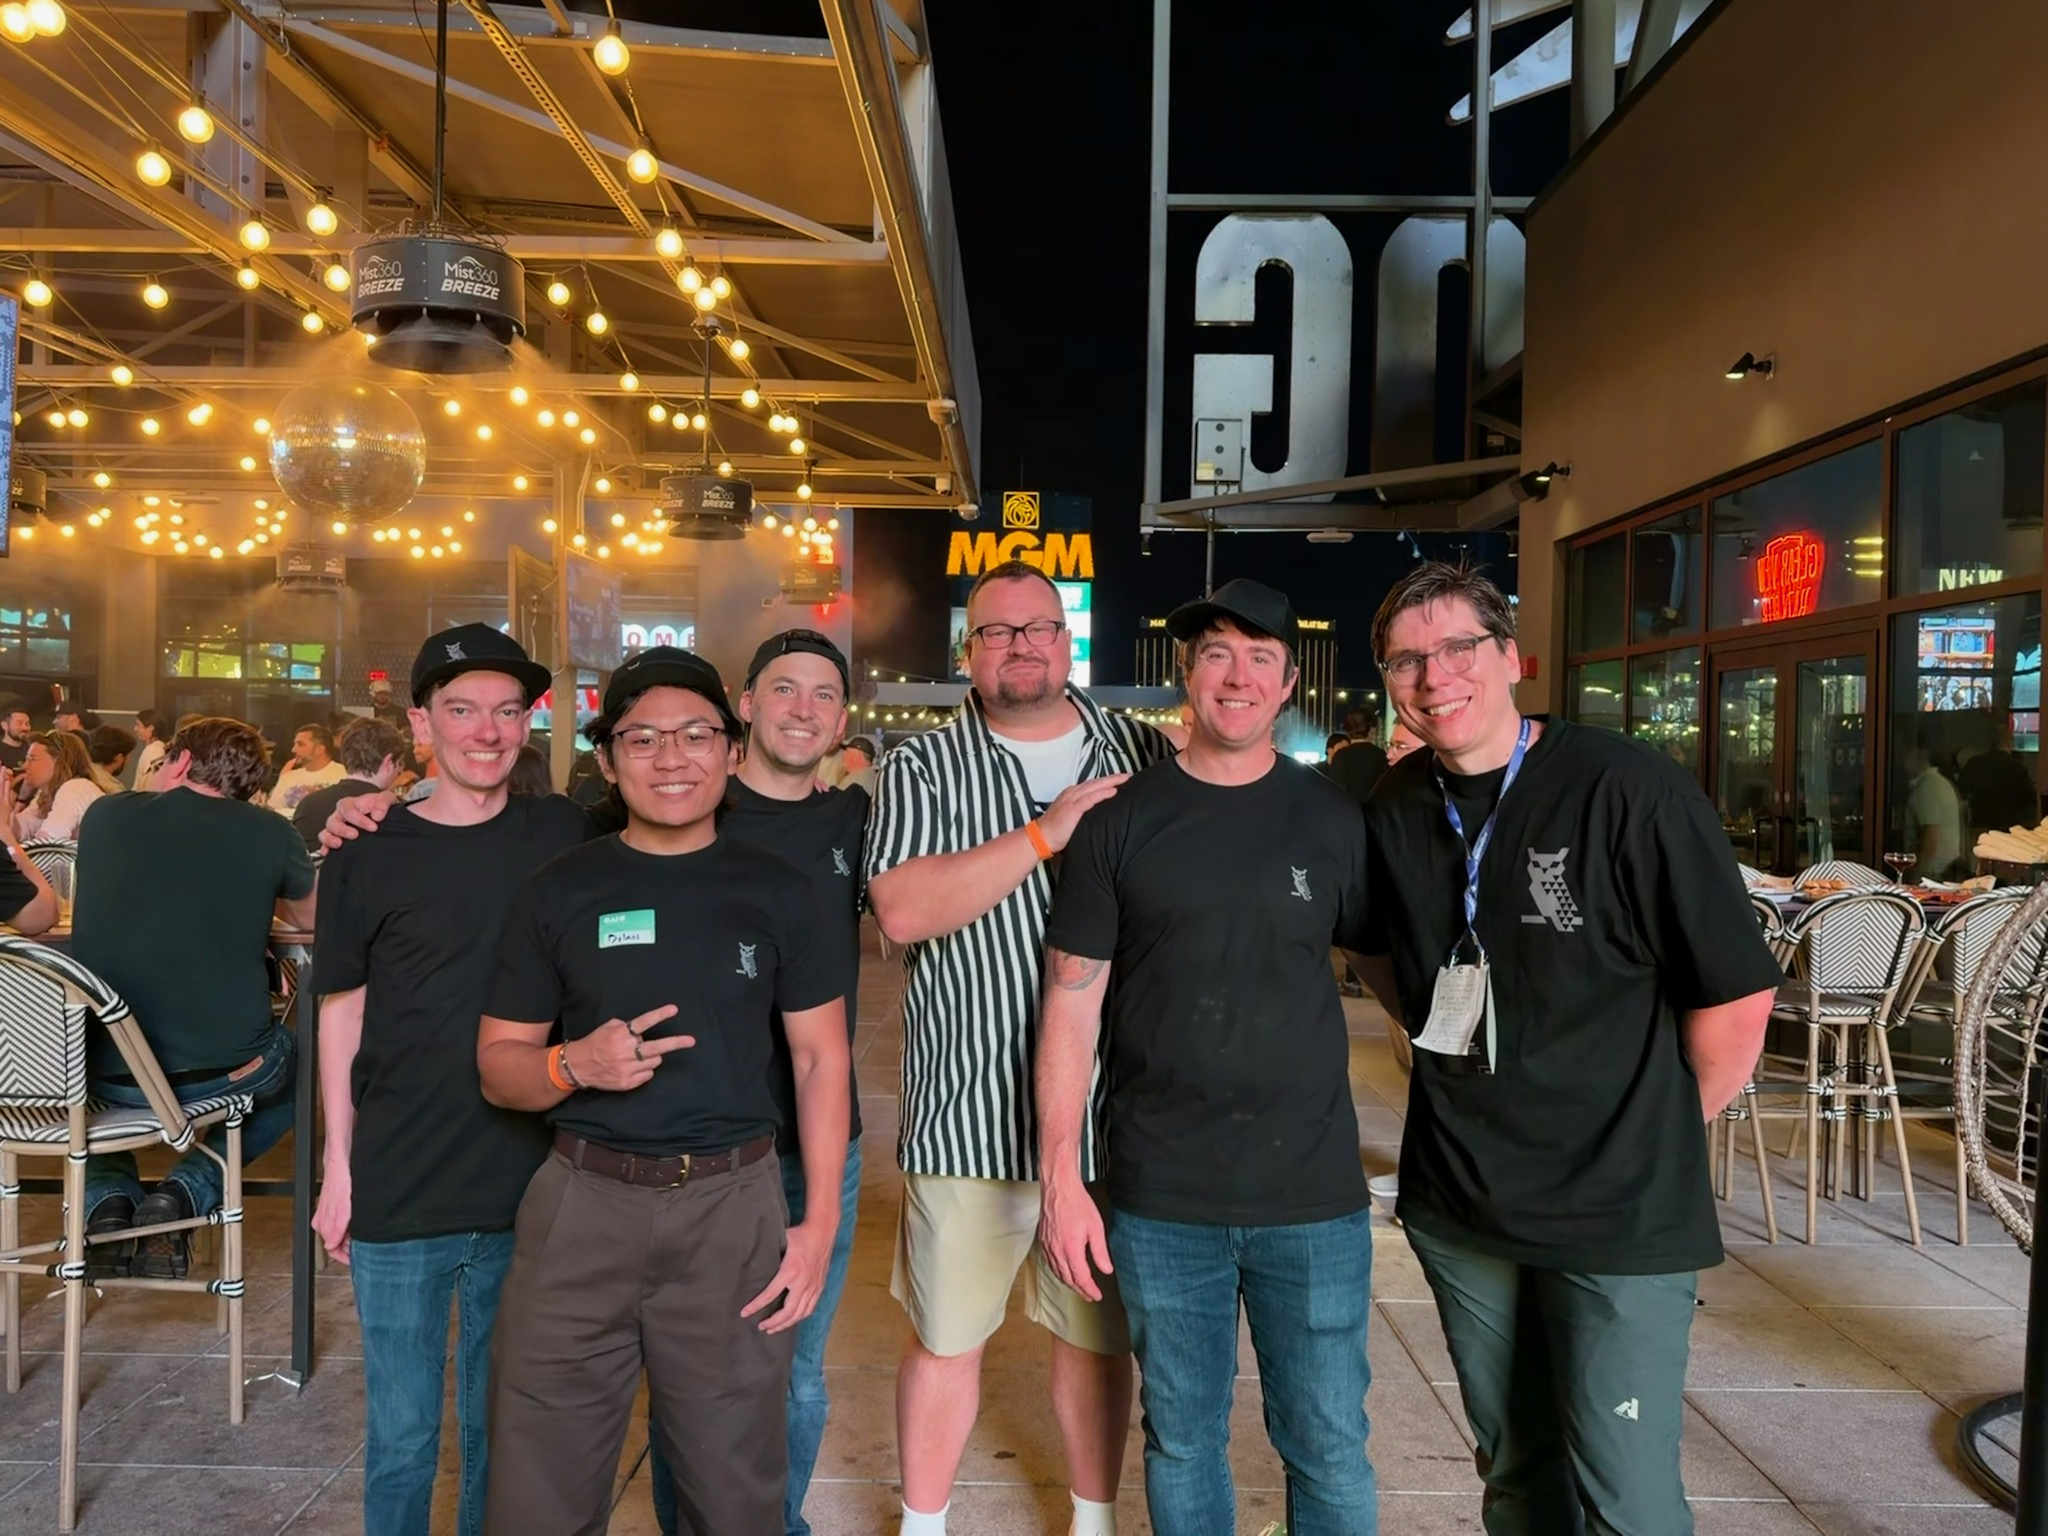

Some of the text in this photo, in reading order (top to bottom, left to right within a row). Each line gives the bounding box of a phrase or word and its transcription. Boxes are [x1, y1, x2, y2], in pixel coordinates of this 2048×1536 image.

[359, 260, 402, 282] Mist360
[444, 261, 498, 286] Mist360
[357, 278, 405, 298] BREEZE
[440, 279, 500, 300] BREEZE
[702, 499, 735, 509] BREEZE
[946, 530, 1094, 578] MGM
